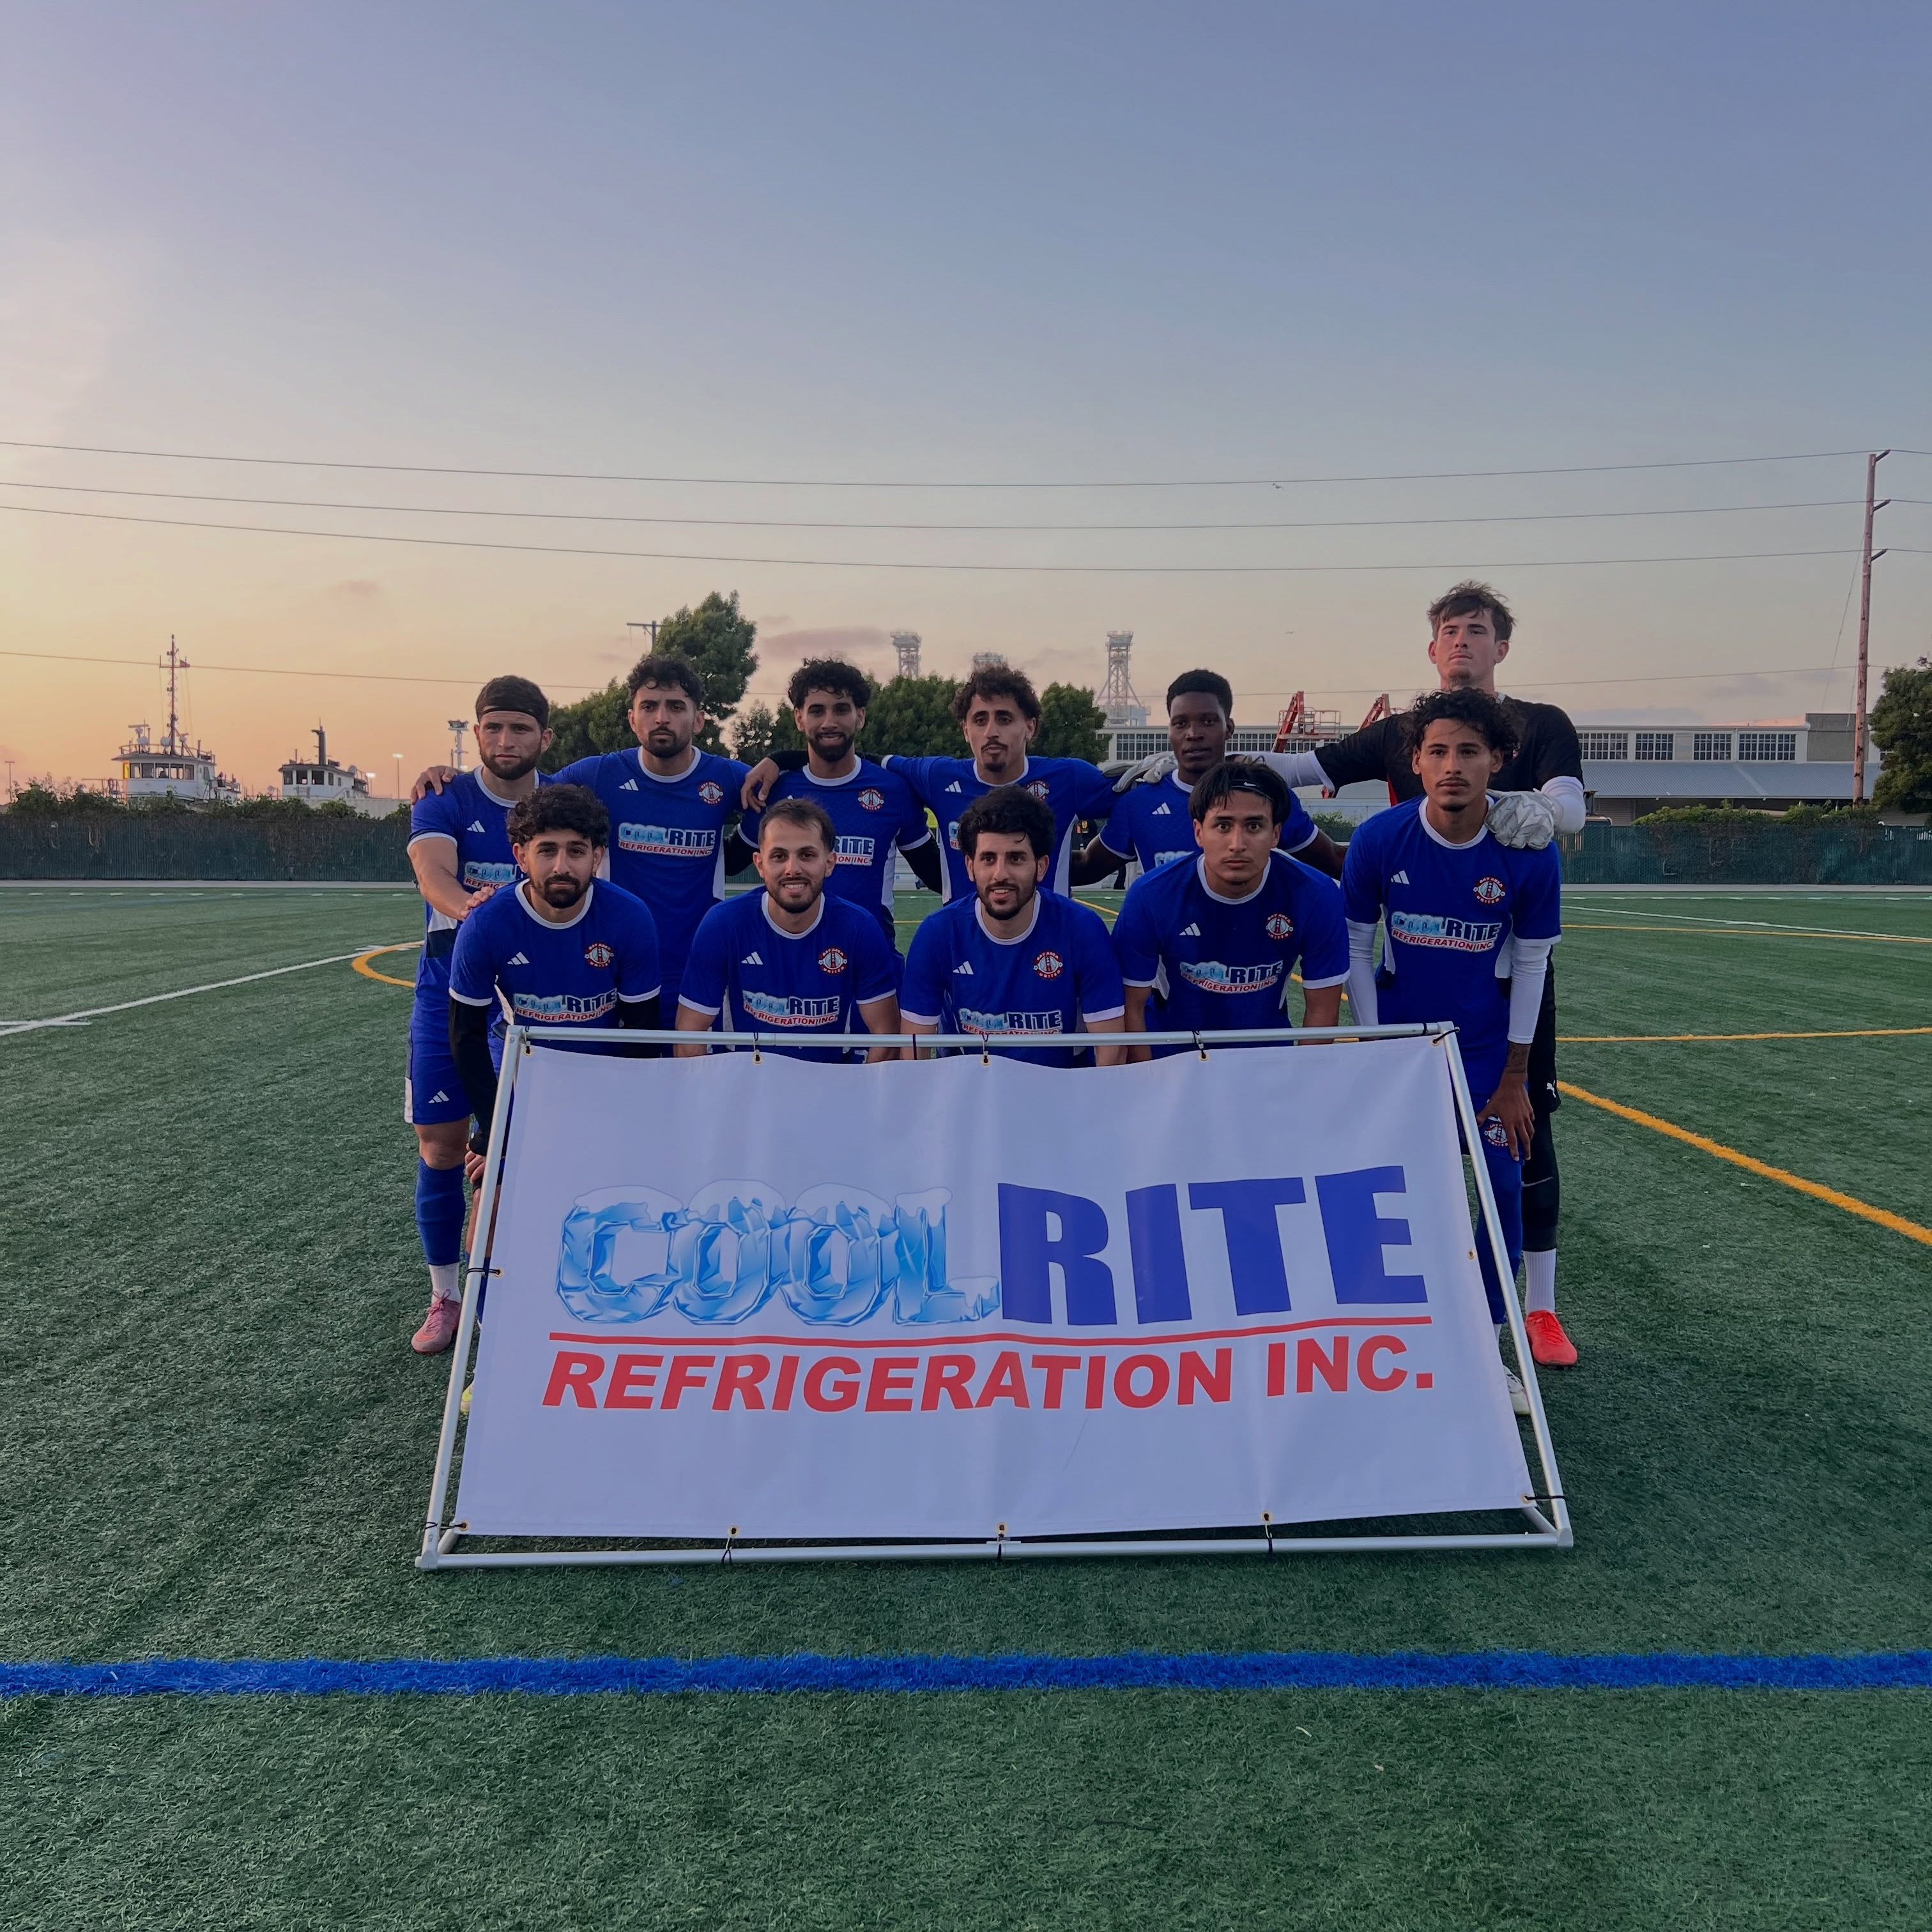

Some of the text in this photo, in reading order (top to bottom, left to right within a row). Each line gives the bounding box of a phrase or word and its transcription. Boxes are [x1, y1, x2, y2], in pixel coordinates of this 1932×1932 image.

[1392, 930, 1473, 950] REFRIGERATION
[542, 1335, 1433, 1413] REFRIGERATION INC.
